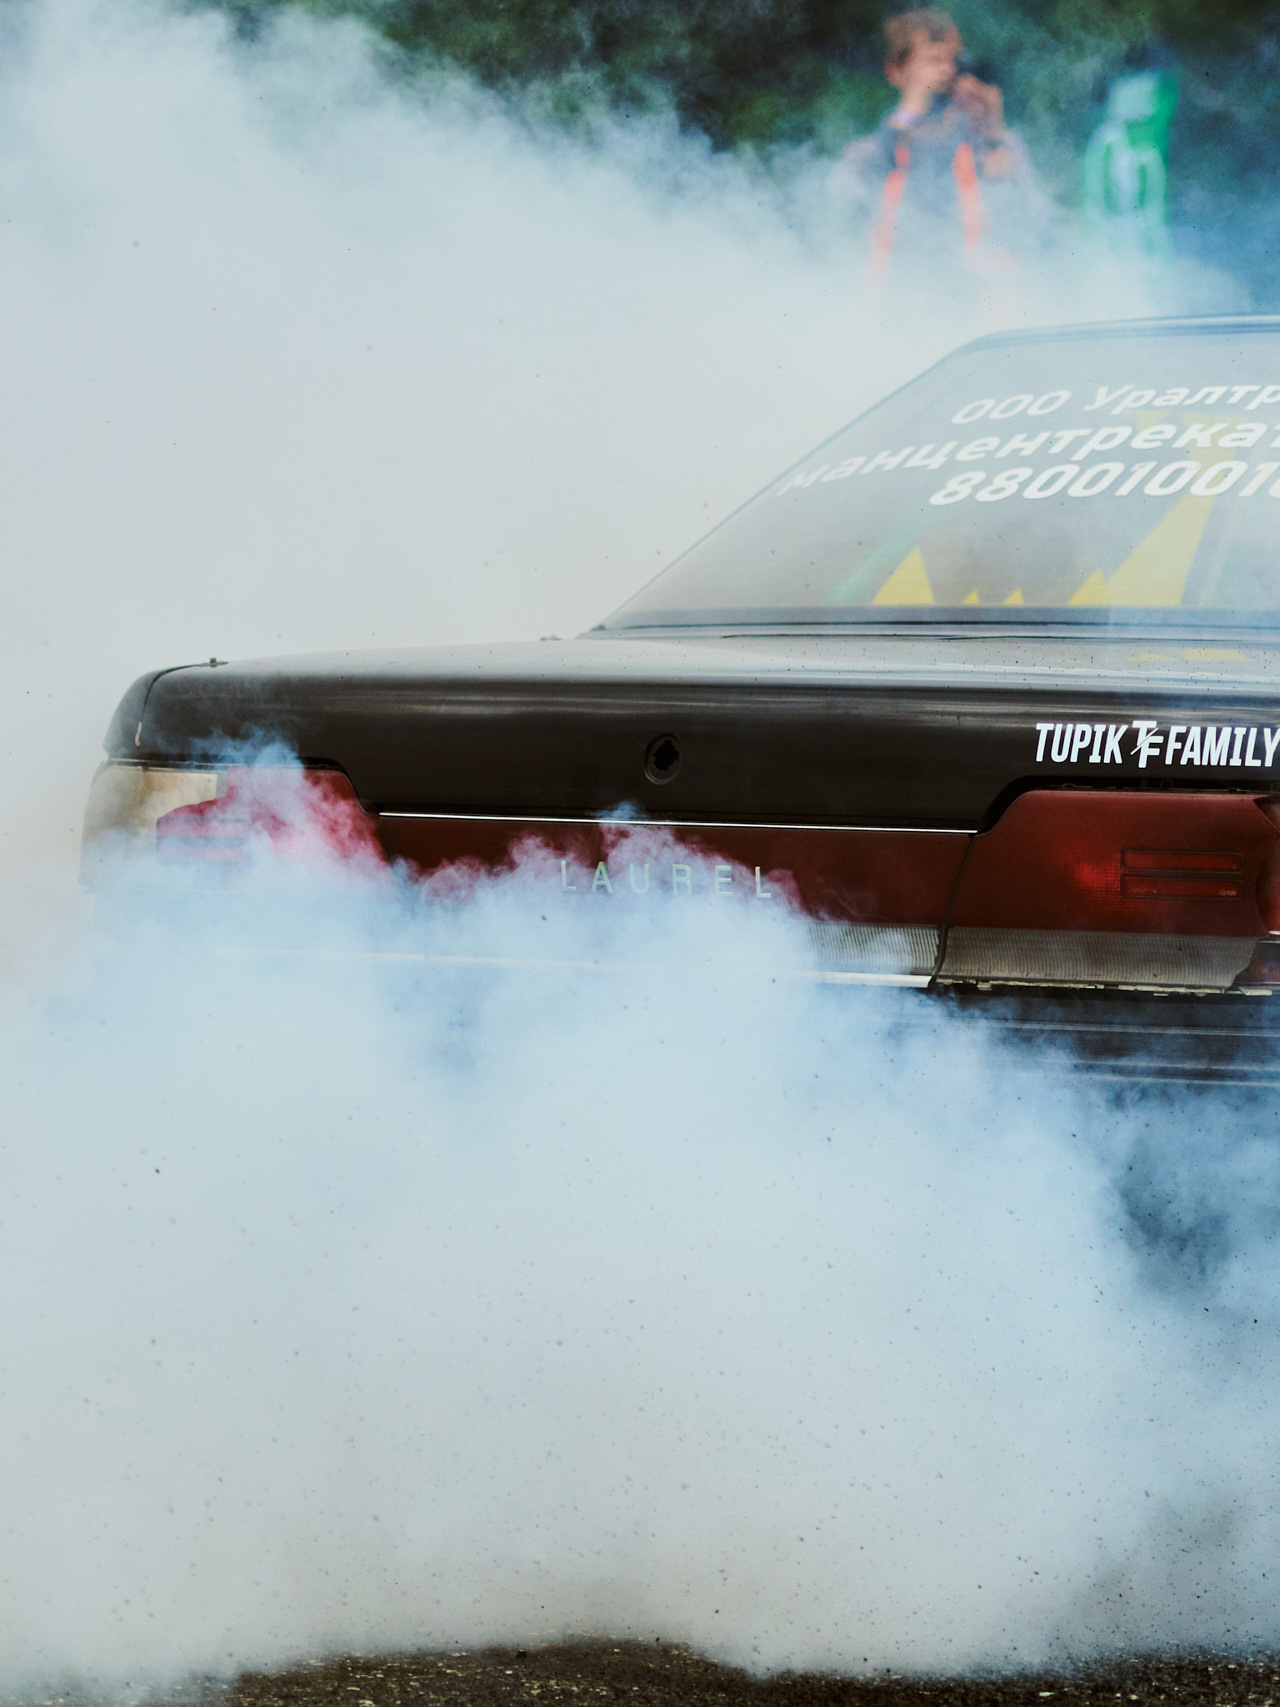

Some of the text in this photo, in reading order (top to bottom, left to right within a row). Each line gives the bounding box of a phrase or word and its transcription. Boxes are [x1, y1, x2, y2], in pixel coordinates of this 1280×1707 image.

[950, 390, 1073, 424] ООО
[1035, 722, 1129, 764] TUPIK
[560, 859, 772, 898] LAUREL
